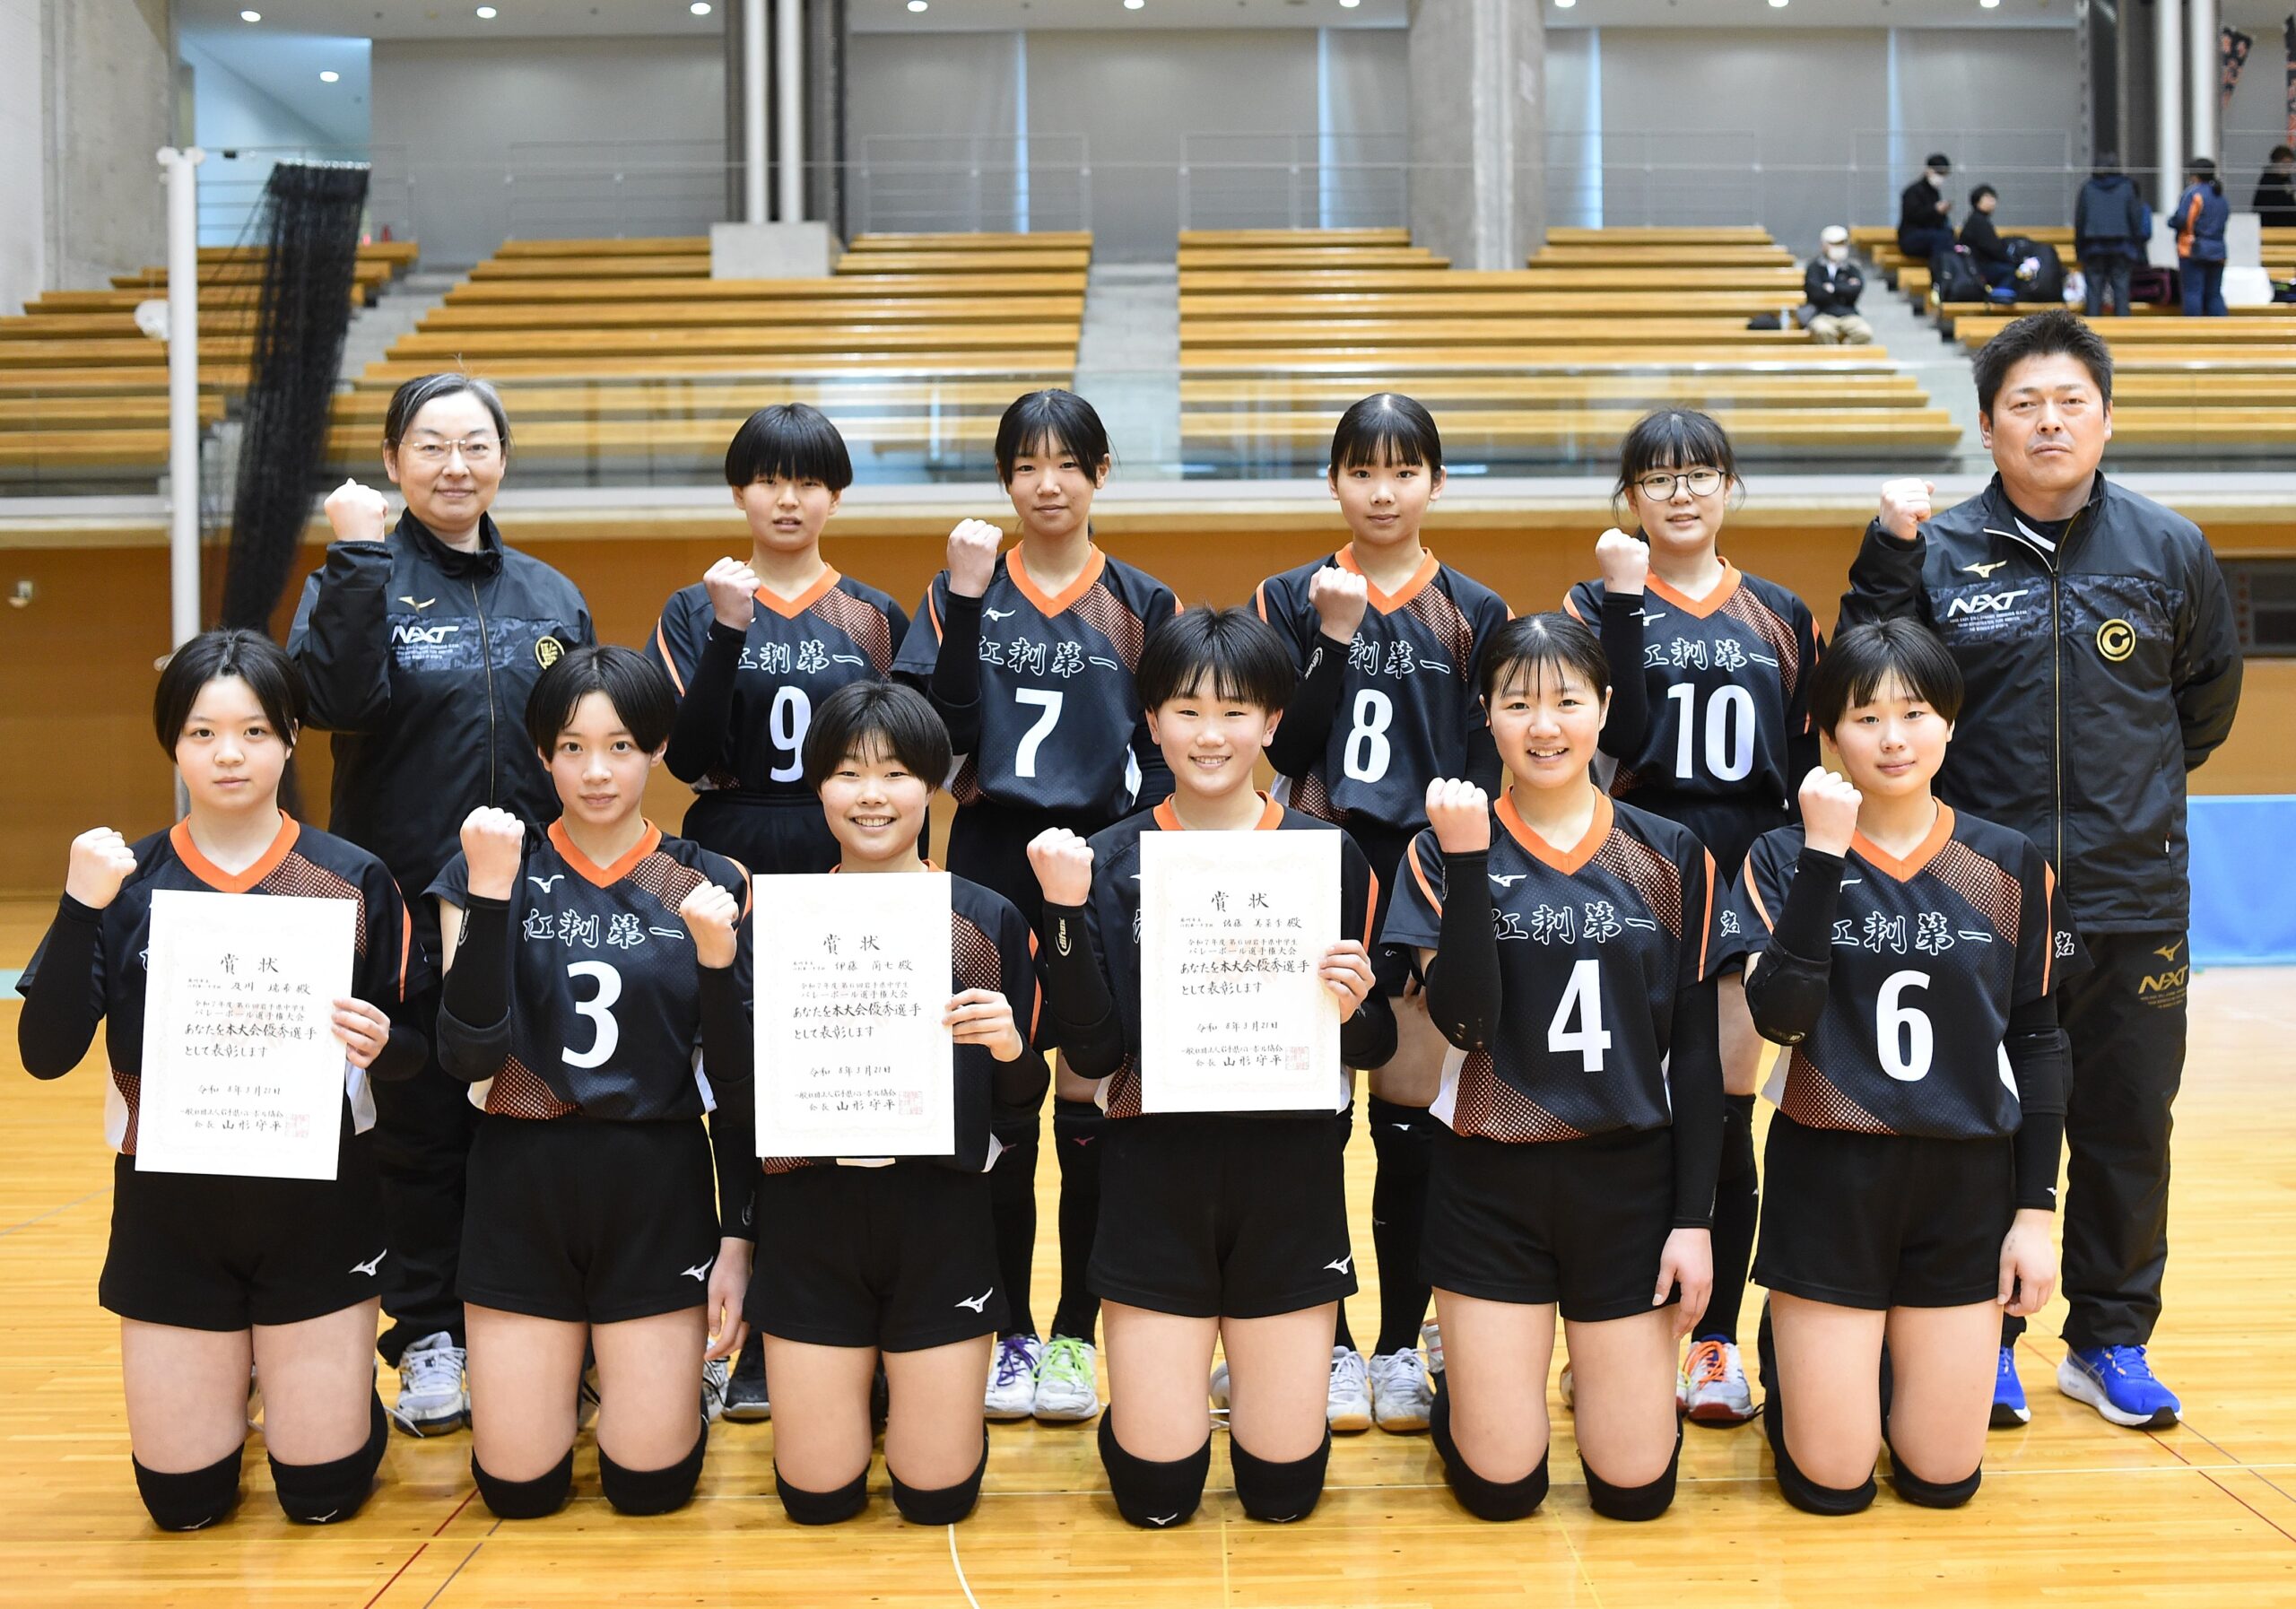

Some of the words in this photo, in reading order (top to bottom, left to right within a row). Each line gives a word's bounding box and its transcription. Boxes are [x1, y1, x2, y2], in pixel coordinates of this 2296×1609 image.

[1348, 632, 1450, 679] 刺第一
[770, 685, 812, 782] 9
[1015, 687, 1063, 778] 7
[1344, 689, 1393, 784] 8
[1667, 683, 1756, 781] 10
[561, 961, 622, 1068] 3
[1547, 959, 1612, 1072] 4
[1875, 970, 1934, 1082] 6
